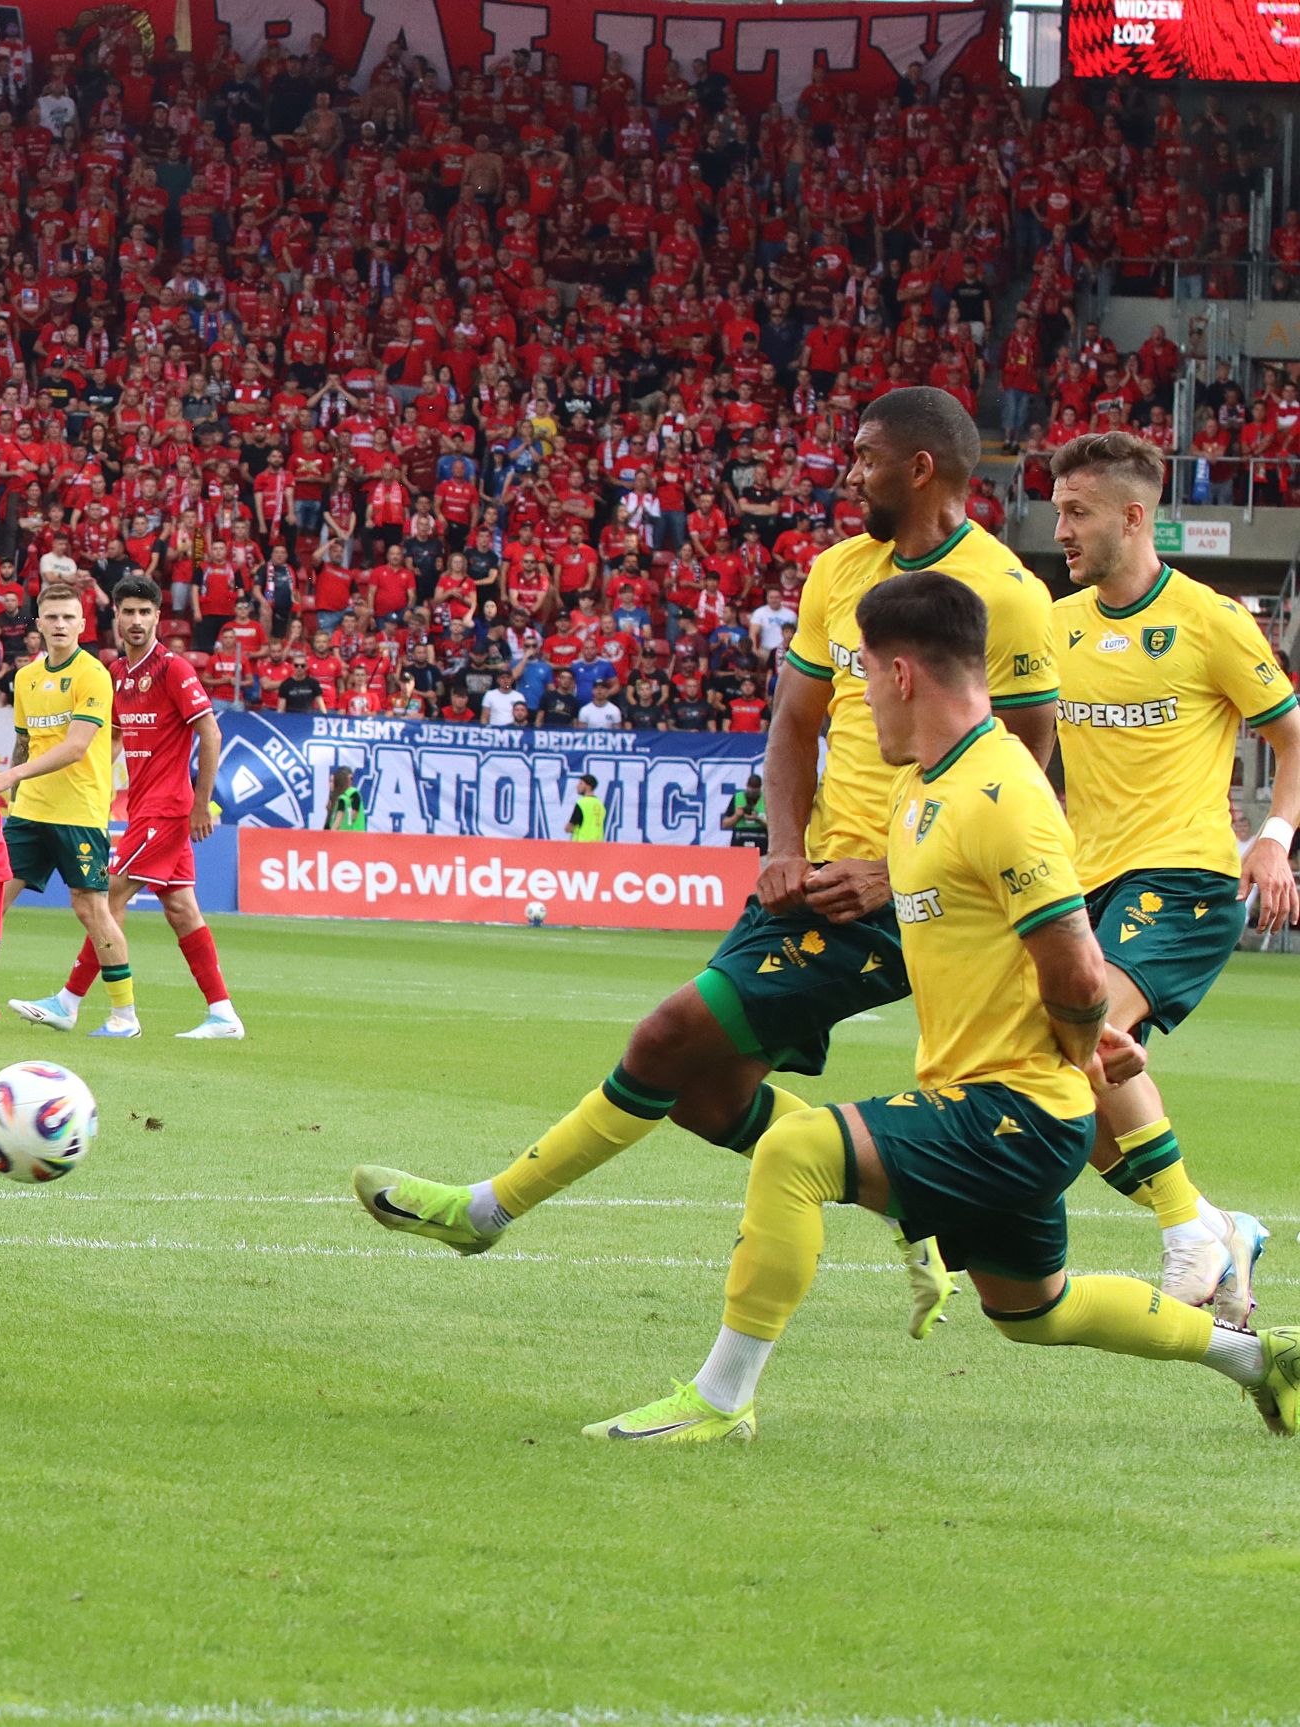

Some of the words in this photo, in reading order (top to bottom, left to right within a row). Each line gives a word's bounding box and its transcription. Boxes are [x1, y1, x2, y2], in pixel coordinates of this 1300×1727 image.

[1114, 0, 1183, 20] WIDZEW
[1112, 20, 1156, 45] ŁÓDŹ
[1188, 527, 1228, 537] BRAMA
[1104, 640, 1126, 650] LOTTO
[1056, 697, 1179, 728] SUPERBET
[312, 716, 410, 744] BYLIŚMY,
[414, 722, 530, 752] JESTEŚMY,
[262, 736, 312, 799] RUCH
[260, 850, 724, 907] sklep.widzew.com
[1001, 858, 1051, 895] Nord
